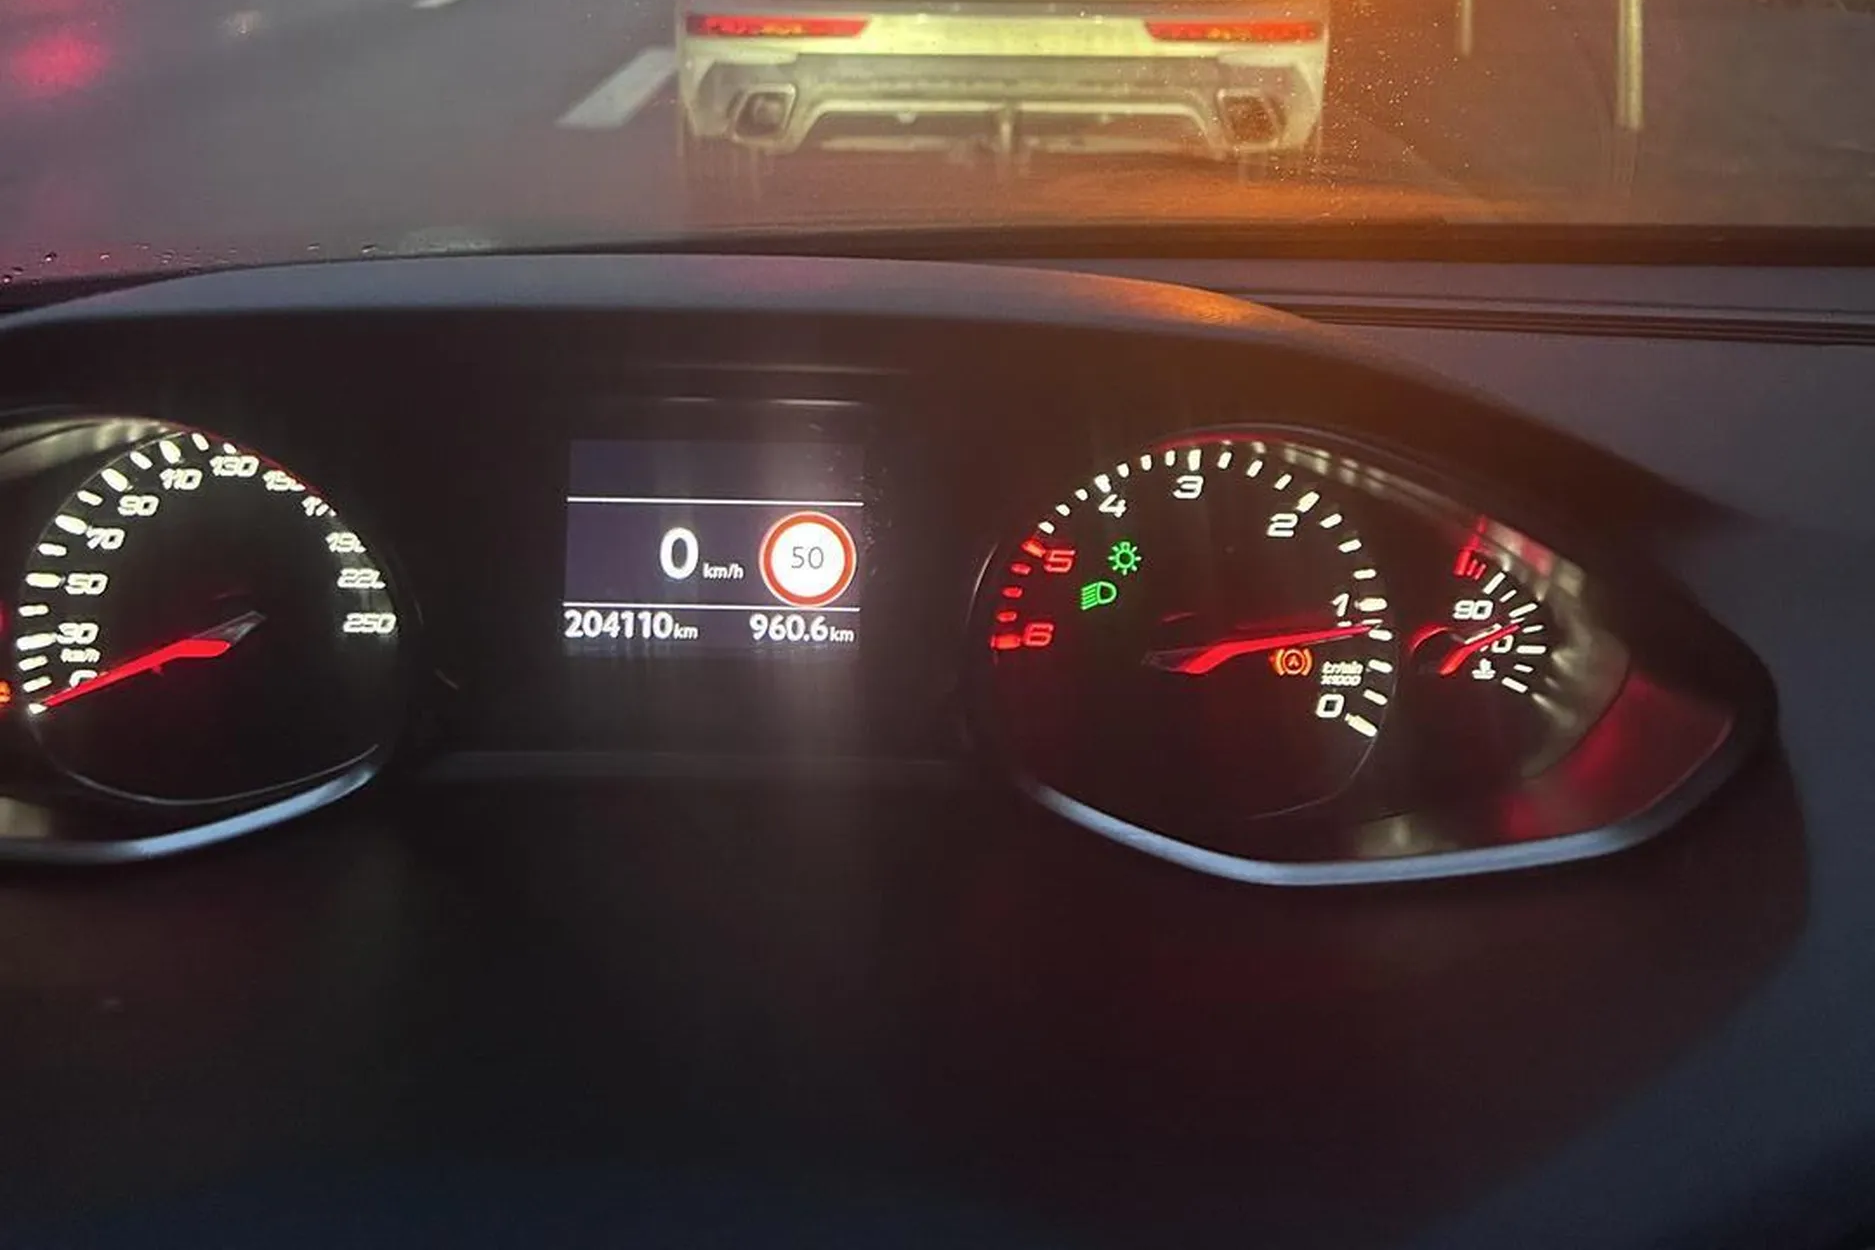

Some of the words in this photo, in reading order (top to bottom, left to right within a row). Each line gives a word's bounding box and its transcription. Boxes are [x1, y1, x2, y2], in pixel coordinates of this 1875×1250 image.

[209, 454, 259, 477] 130
[159, 467, 202, 491] 110
[1173, 475, 1204, 499] 3
[117, 494, 160, 517] 90
[1098, 493, 1127, 518] 4
[1266, 512, 1298, 538] 2
[88, 527, 126, 551] 70
[659, 526, 699, 581] 0
[702, 562, 744, 580] km/h
[790, 546, 824, 569] 50
[1044, 550, 1076, 573] 5
[65, 572, 108, 596] 50
[1332, 593, 1350, 617] 1
[1452, 599, 1494, 621] 90
[56, 622, 99, 645] 30
[343, 611, 397, 635] 250
[1023, 623, 1054, 647] 6
[1315, 693, 1346, 719] 0
